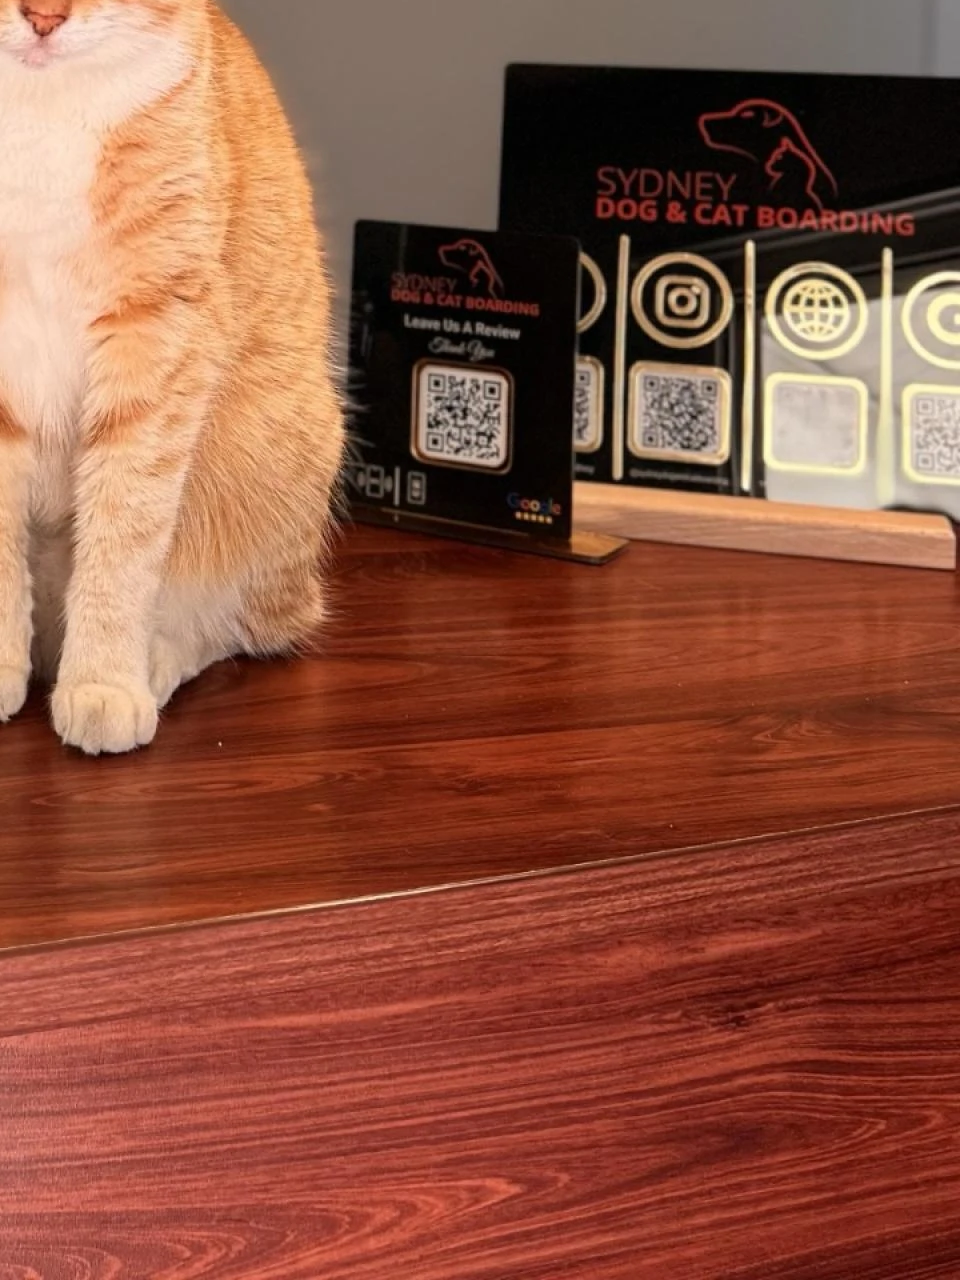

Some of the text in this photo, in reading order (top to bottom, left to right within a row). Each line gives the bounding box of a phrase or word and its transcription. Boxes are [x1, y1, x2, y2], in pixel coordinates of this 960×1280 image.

[596, 166, 737, 202] SYDNEY
[596, 197, 916, 236] DOG & CAT BOARDING
[392, 271, 457, 293] SYDNEY
[391, 289, 540, 317] DOG & CAT BOARDING
[403, 313, 521, 340] Leave Us A Review
[507, 492, 562, 516] Google
